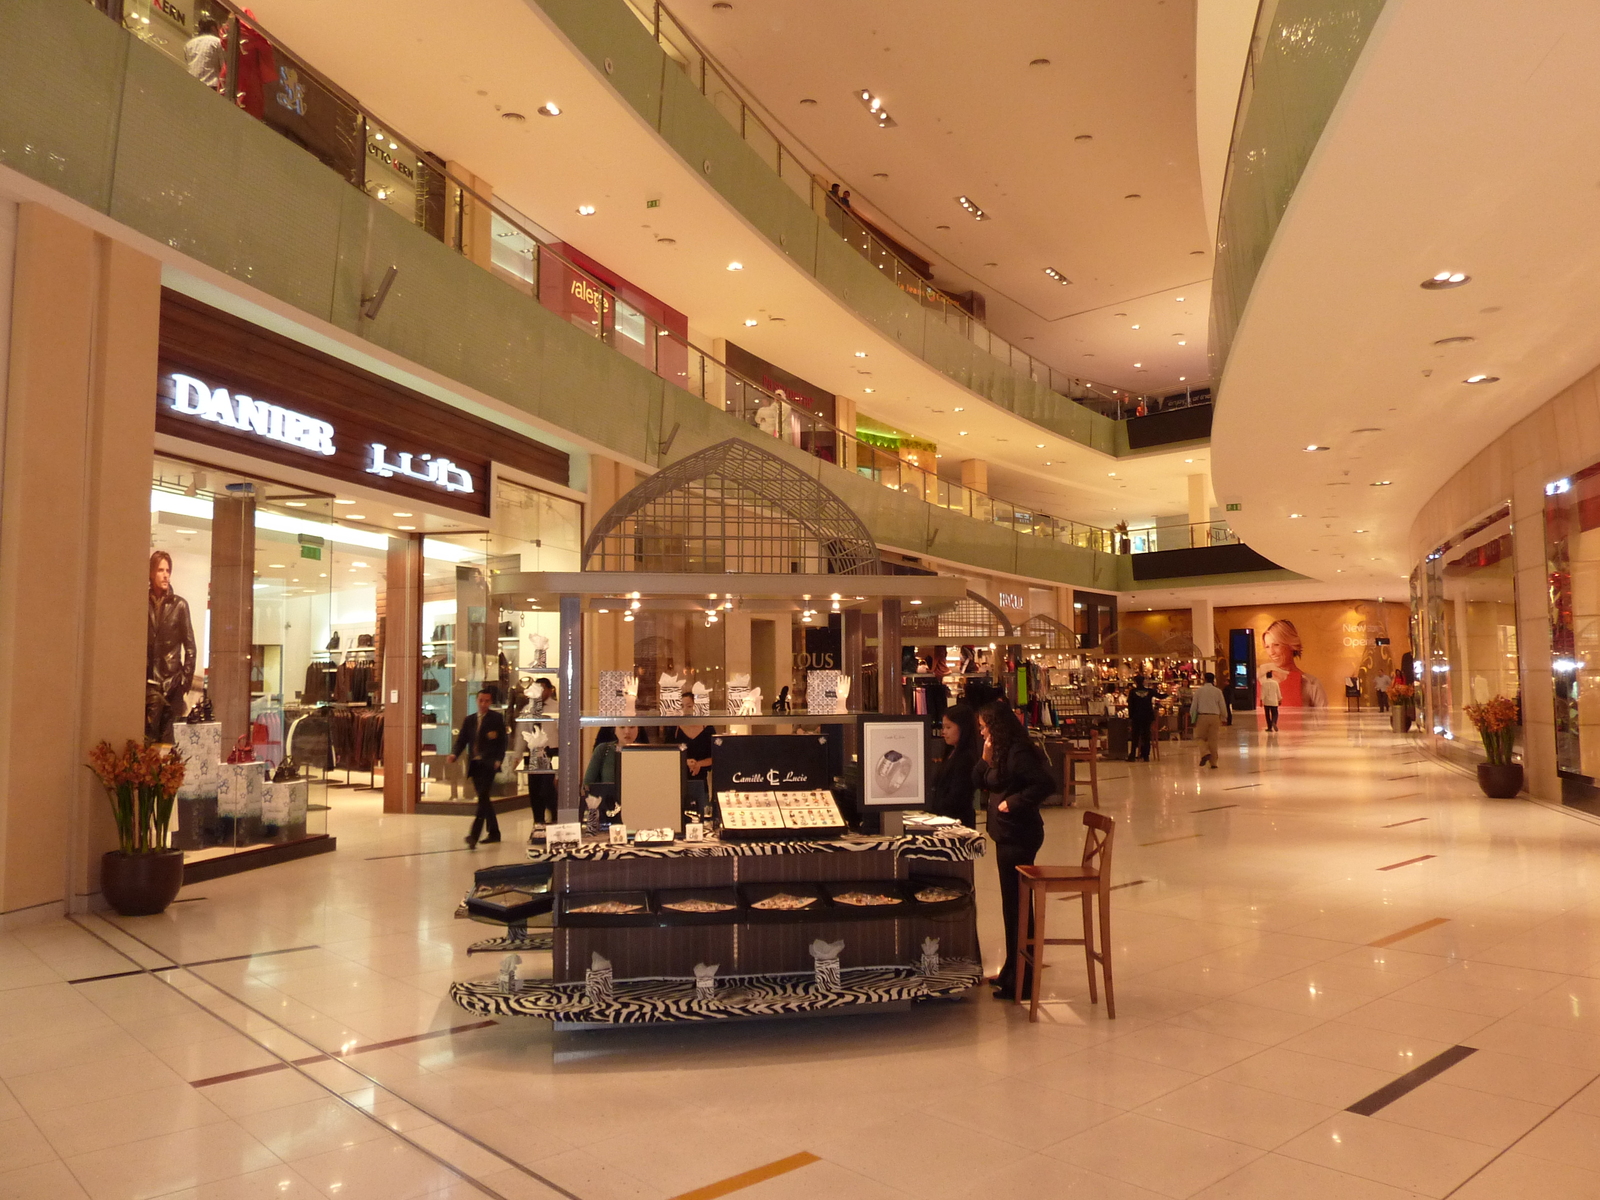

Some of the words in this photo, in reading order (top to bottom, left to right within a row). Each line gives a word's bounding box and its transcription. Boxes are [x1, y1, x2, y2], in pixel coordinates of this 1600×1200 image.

[368, 142, 391, 165] OTTO
[392, 158, 414, 180] KERN
[170, 373, 336, 455] DANIER
[1342, 624, 1367, 633] New
[792, 652, 834, 668] TOUS
[732, 771, 764, 784] Camille
[783, 770, 808, 783] Lucie
